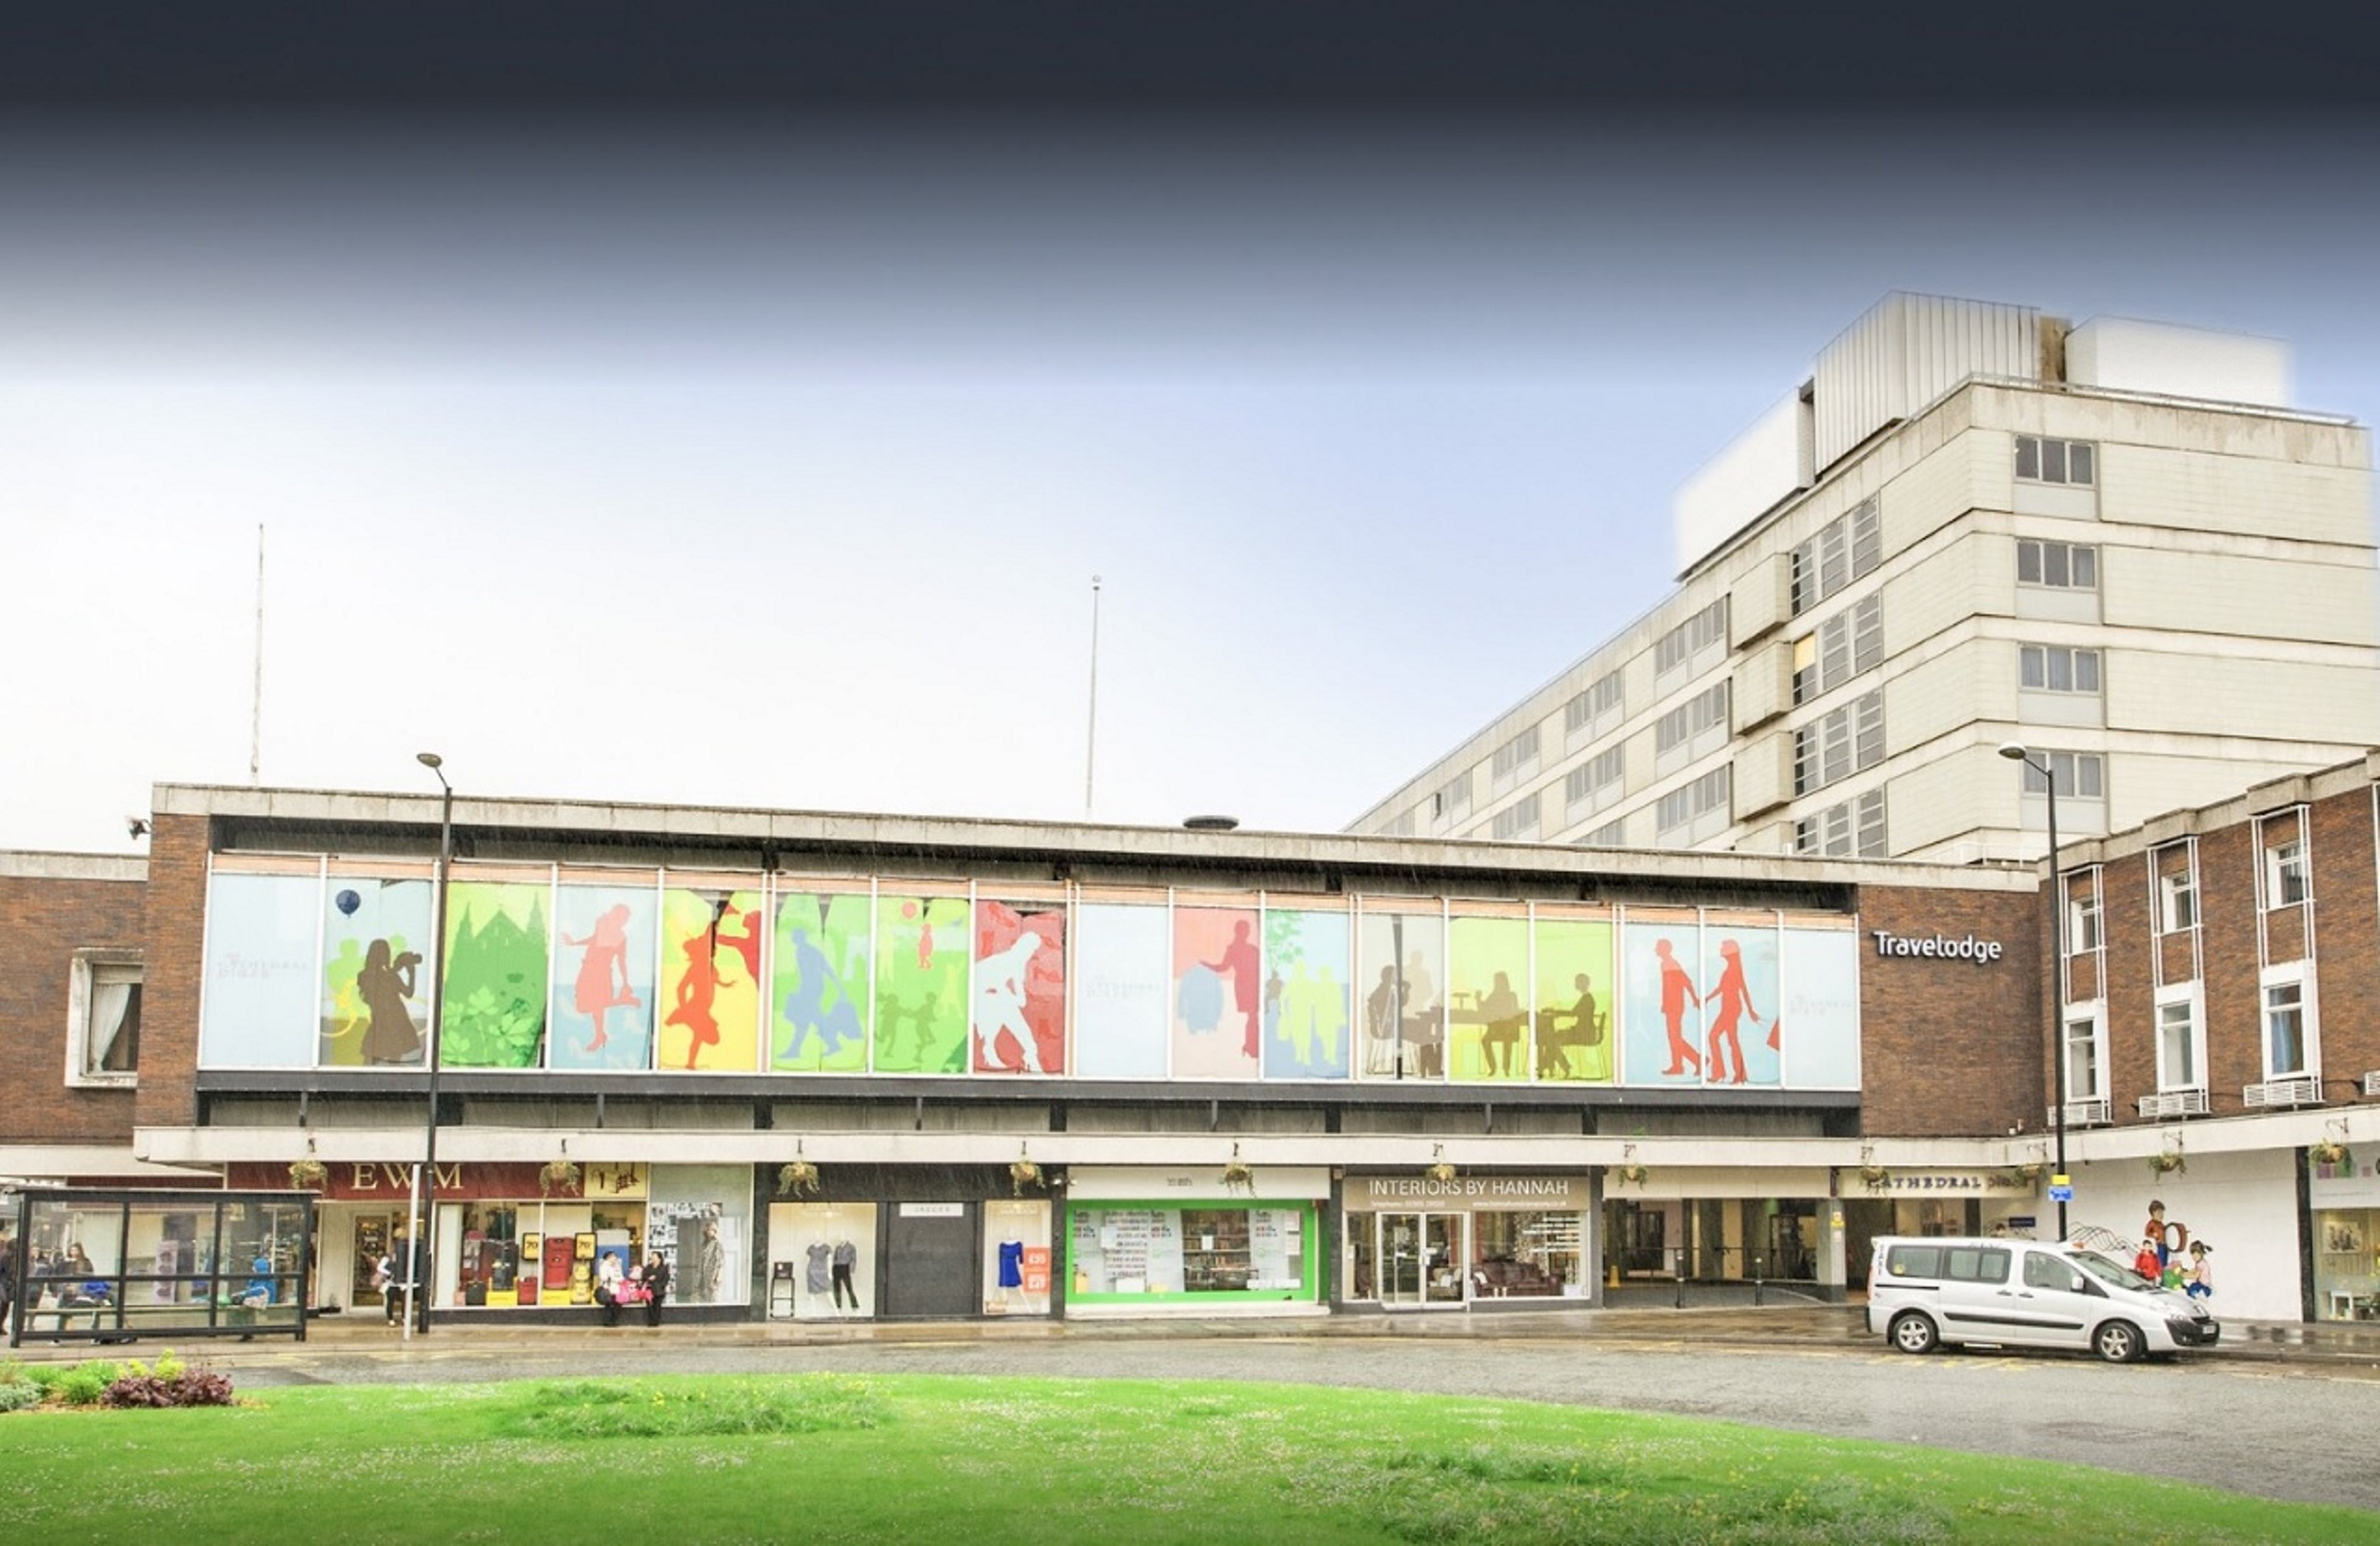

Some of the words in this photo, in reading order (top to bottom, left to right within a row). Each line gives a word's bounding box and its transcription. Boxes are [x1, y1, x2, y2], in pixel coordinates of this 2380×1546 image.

[1873, 930, 2003, 964] Travelodge
[350, 1162, 466, 1190] EWM
[1869, 1176, 1982, 1189] ATHEDRAL
[1369, 1179, 1462, 1197] INTERIORS
[1466, 1179, 1486, 1196] BY
[1492, 1179, 1569, 1196] HANNAH
